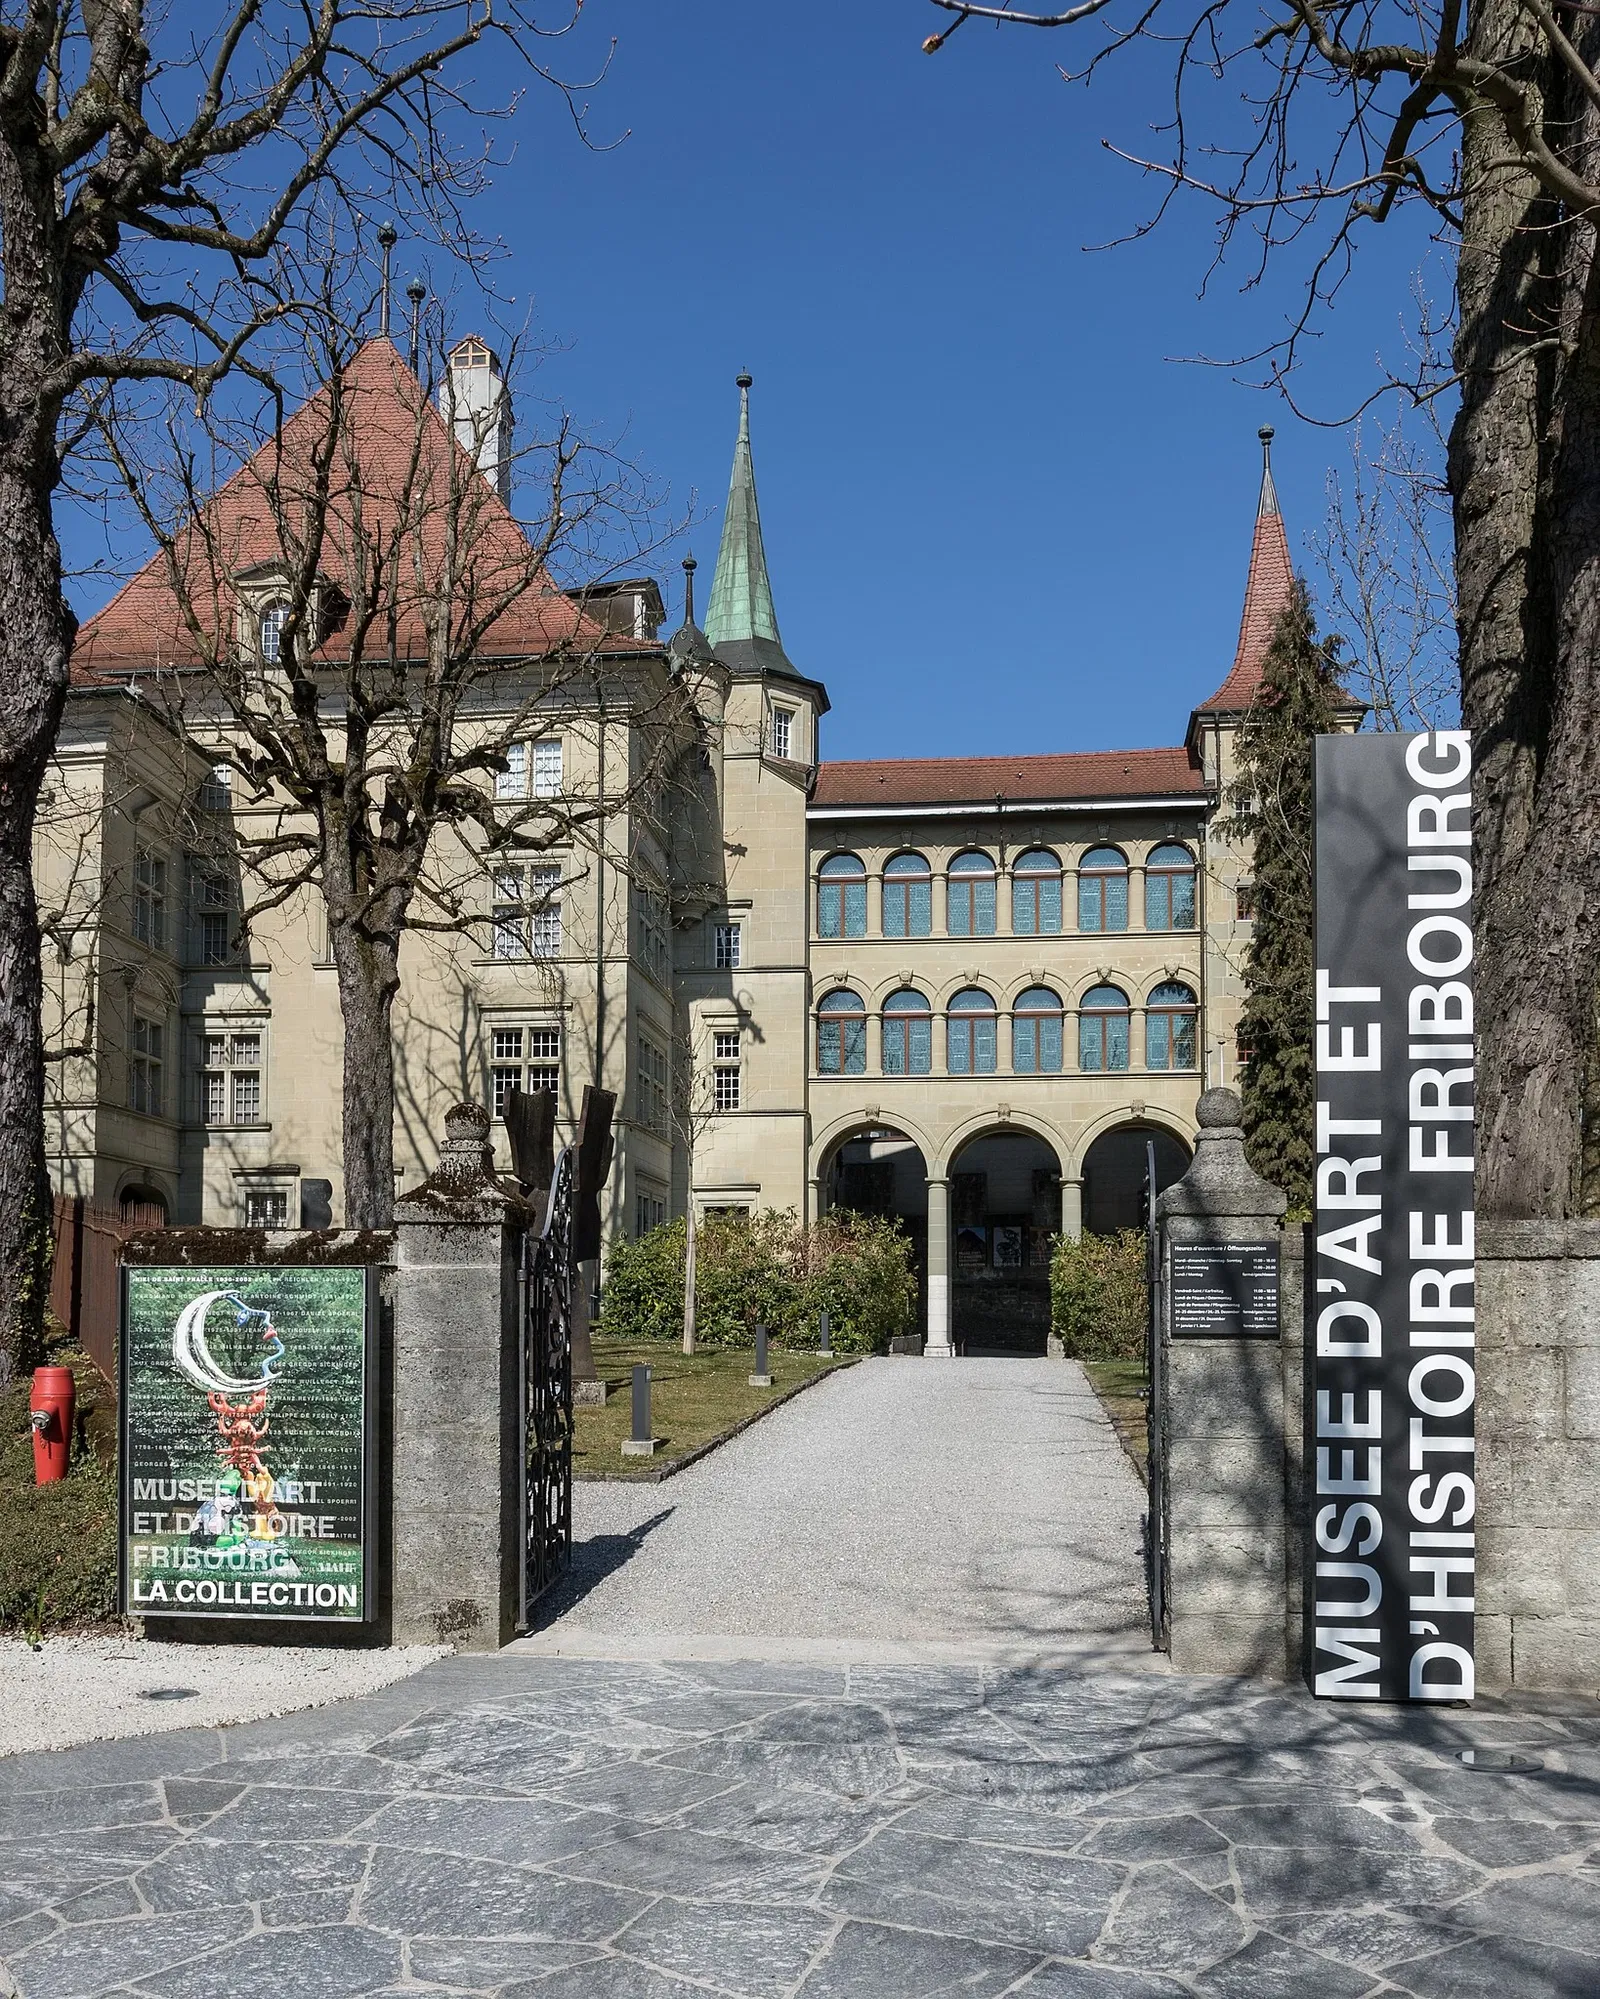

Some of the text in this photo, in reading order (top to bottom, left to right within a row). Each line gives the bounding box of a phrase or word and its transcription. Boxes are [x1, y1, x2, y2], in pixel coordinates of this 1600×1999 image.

[1405, 729, 1476, 1700] D'HISTOIRE FRIBOURG
[1315, 969, 1383, 1697] MUSEE D'ART ET
[133, 1478, 239, 1502] MUSEE
[133, 1512, 168, 1534] ET
[133, 1545, 290, 1571] FRIBOURG
[132, 1578, 168, 1602] LA
[175, 1579, 358, 1608] COLLECTION
